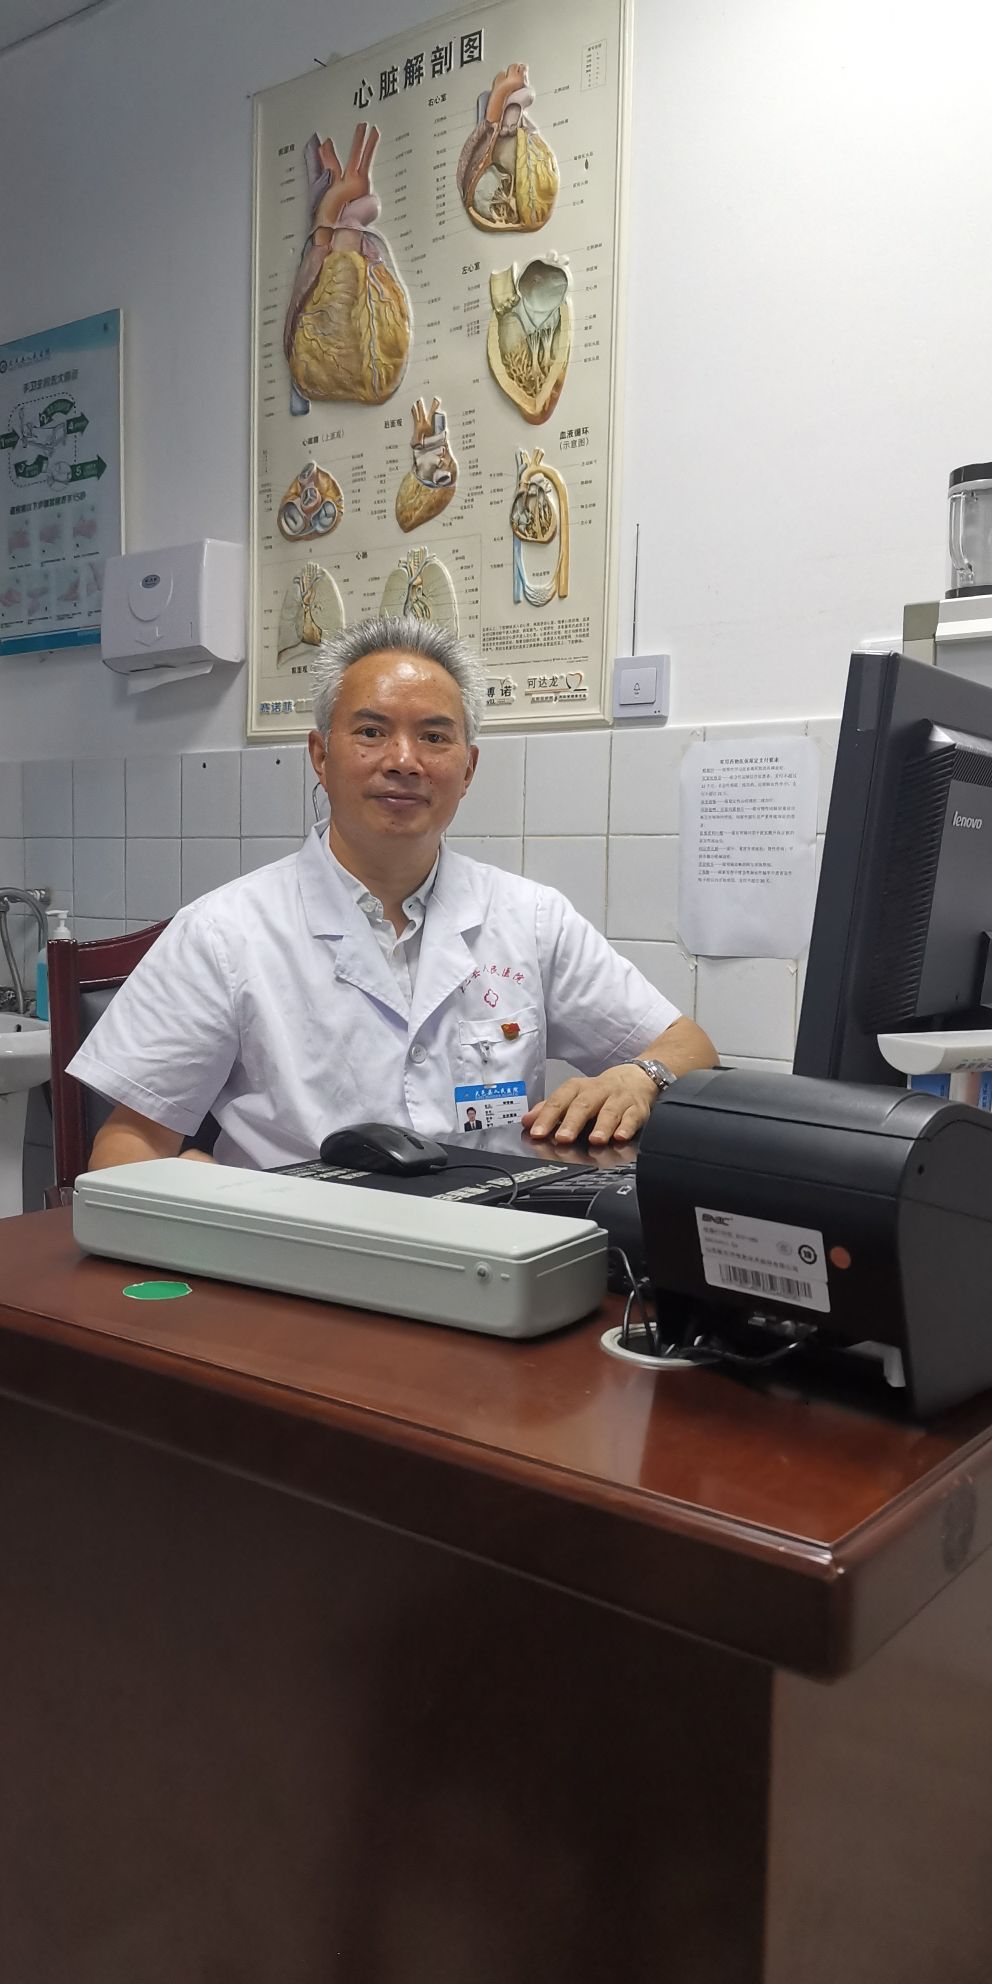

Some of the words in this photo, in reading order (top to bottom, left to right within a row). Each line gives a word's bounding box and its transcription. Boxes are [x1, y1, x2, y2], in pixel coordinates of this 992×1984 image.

[353, 29, 482, 109] 心脏解剖图
[560, 427, 590, 440] 血液循环
[75, 466, 82, 477] 5
[527, 676, 559, 689] 可达龙
[953, 811, 983, 830] lenovo
